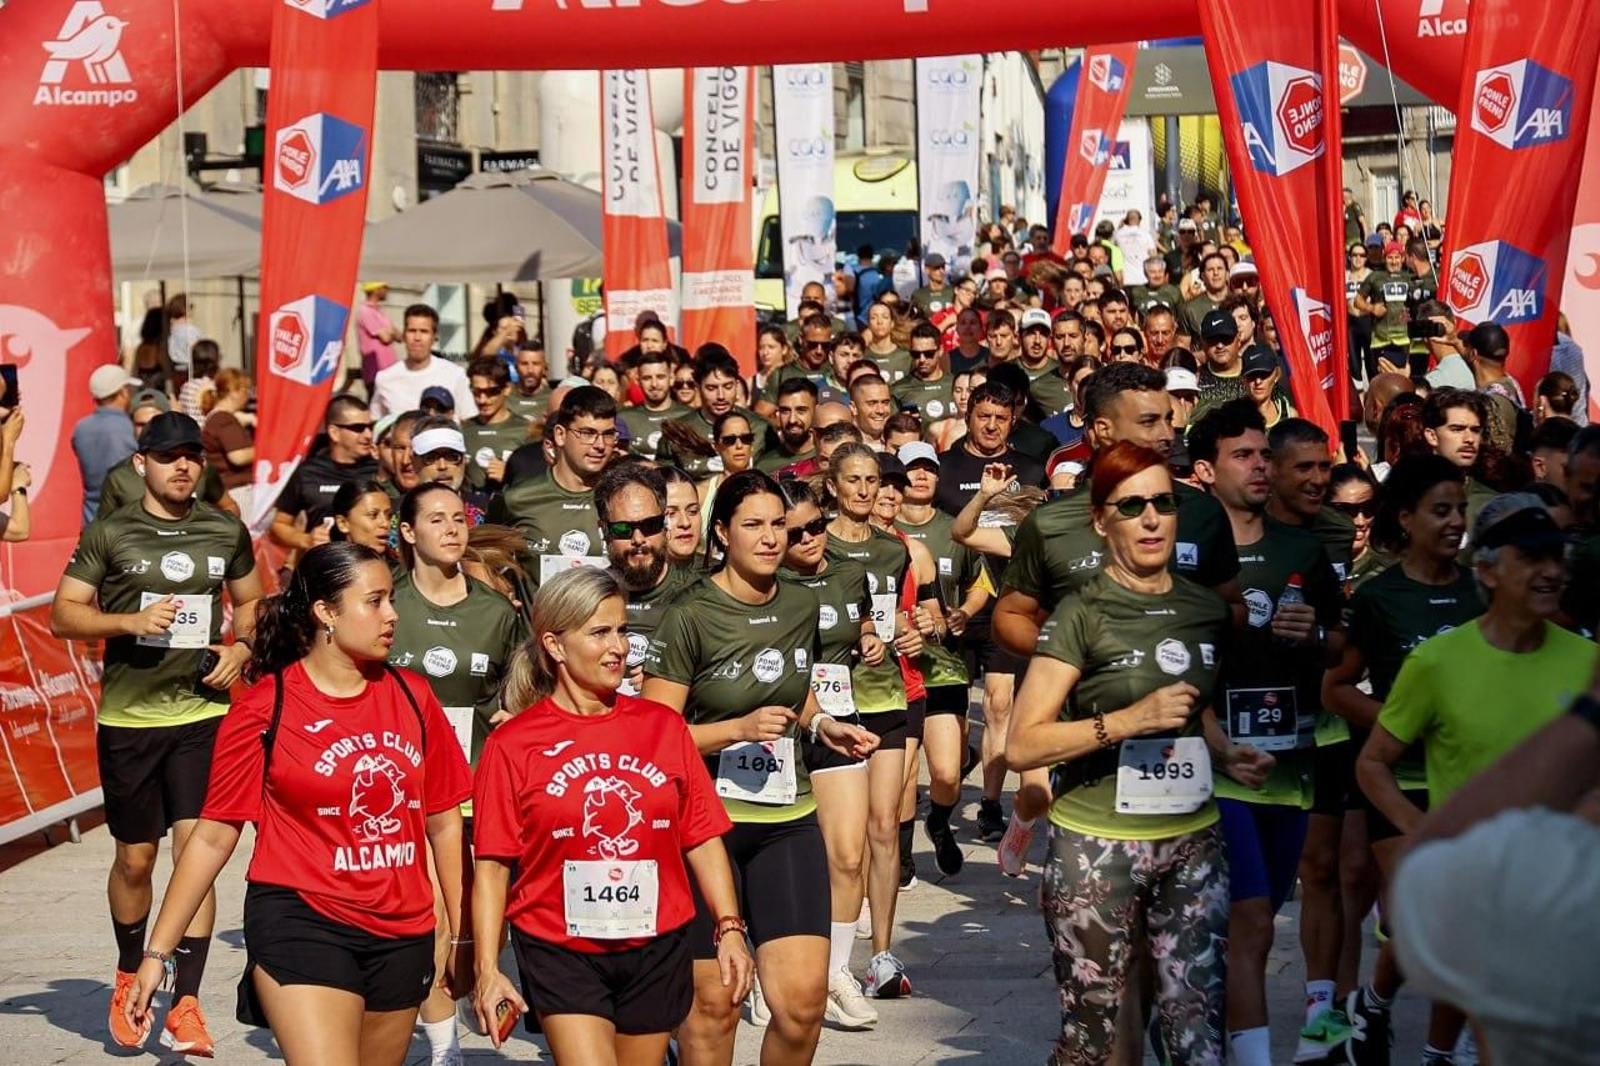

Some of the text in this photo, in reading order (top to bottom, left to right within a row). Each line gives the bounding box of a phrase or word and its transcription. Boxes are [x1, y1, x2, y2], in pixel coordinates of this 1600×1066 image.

[32, 85, 138, 108] Alcampo
[1478, 95, 1505, 120] FRENO
[1481, 86, 1510, 109] PONLE
[722, 66, 741, 173] DE VIGO
[1514, 107, 1563, 142] AXA
[318, 158, 362, 197] AXA
[1487, 287, 1538, 321] AXA
[1257, 707, 1282, 723] 29
[313, 731, 422, 777] SPORTS CLUB
[545, 752, 667, 798] SPORTS CLUB
[1138, 761, 1195, 781] 1093
[317, 806, 341, 816] SINCE
[583, 884, 641, 904] 1464
